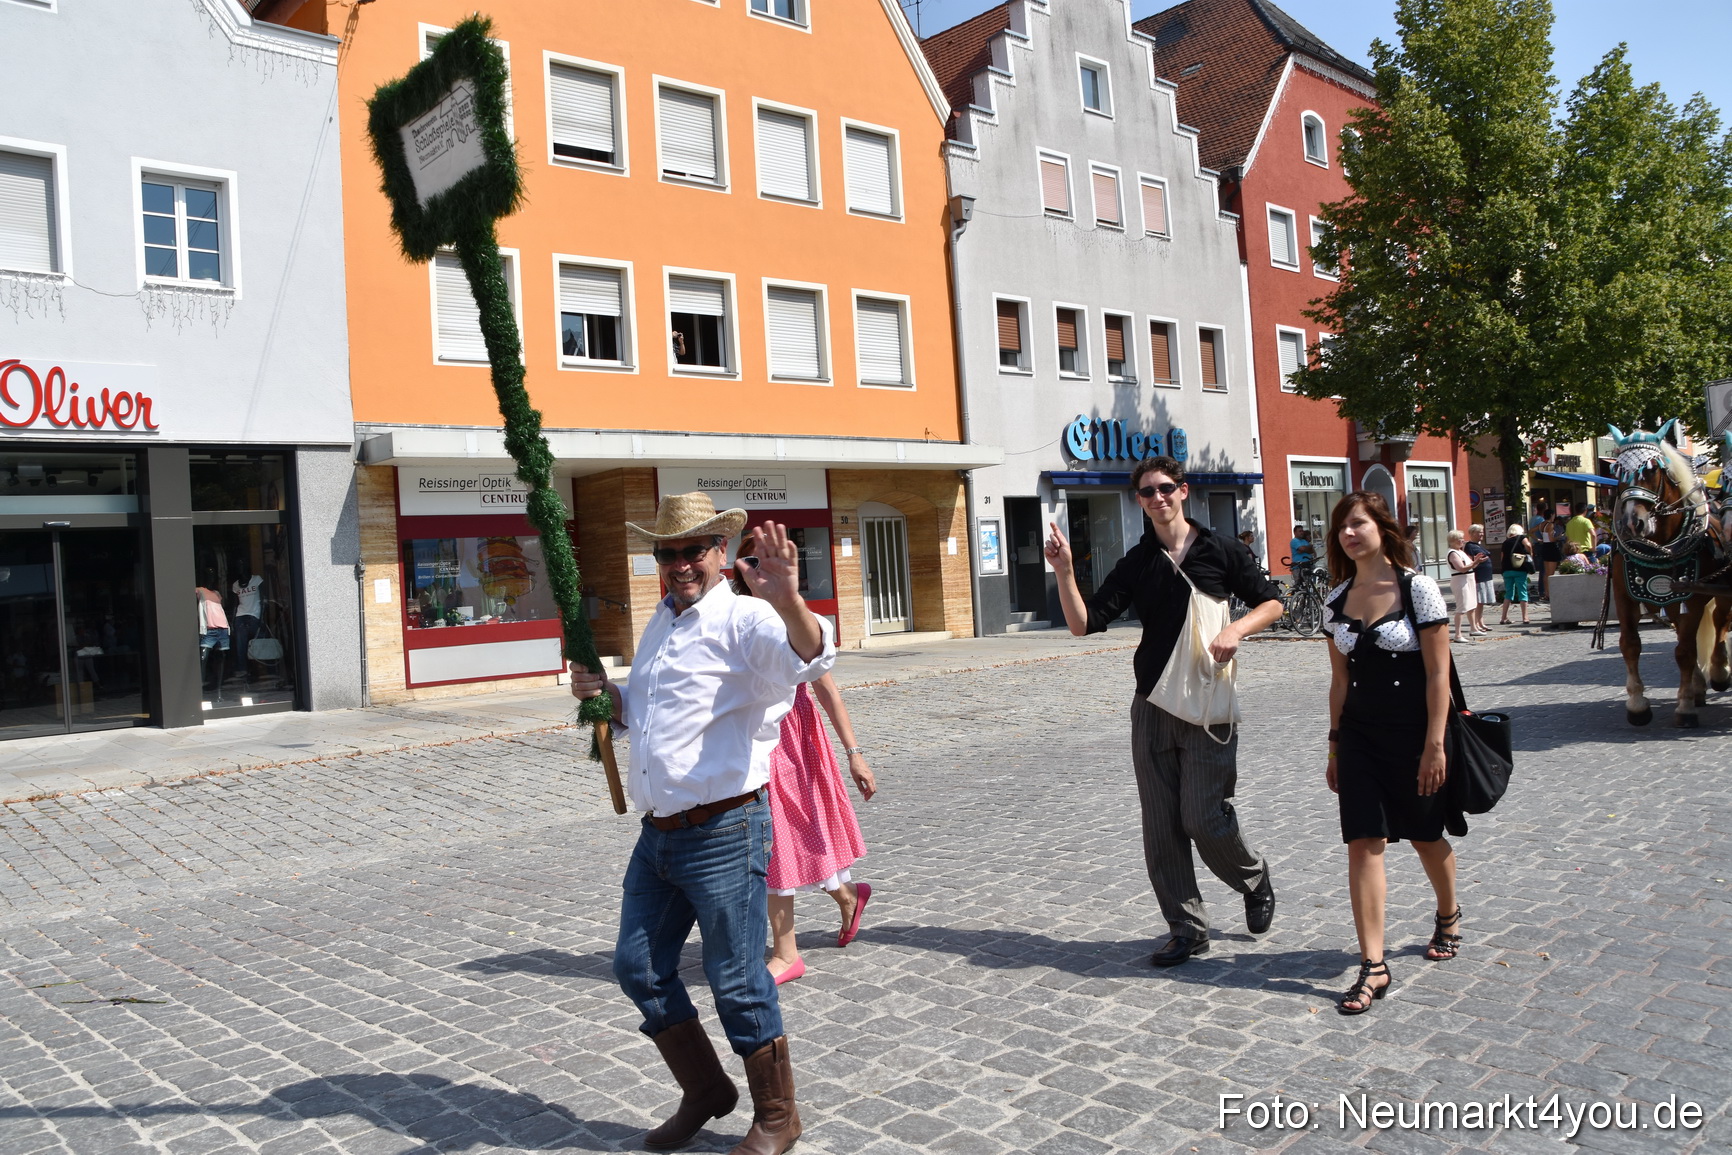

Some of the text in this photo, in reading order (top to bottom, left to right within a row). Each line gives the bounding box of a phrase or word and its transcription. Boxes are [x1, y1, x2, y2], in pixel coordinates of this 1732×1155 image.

[0, 359, 160, 429] Oliver
[1065, 414, 1165, 461] Eilles
[418, 477, 512, 490] Reissinger Optik
[697, 478, 768, 489] Reissinger Optik
[482, 494, 529, 504] CENTRU
[745, 492, 786, 501] CENTRUM
[984, 496, 991, 504] 31
[841, 516, 849, 524] 30
[236, 585, 257, 595] SALE
